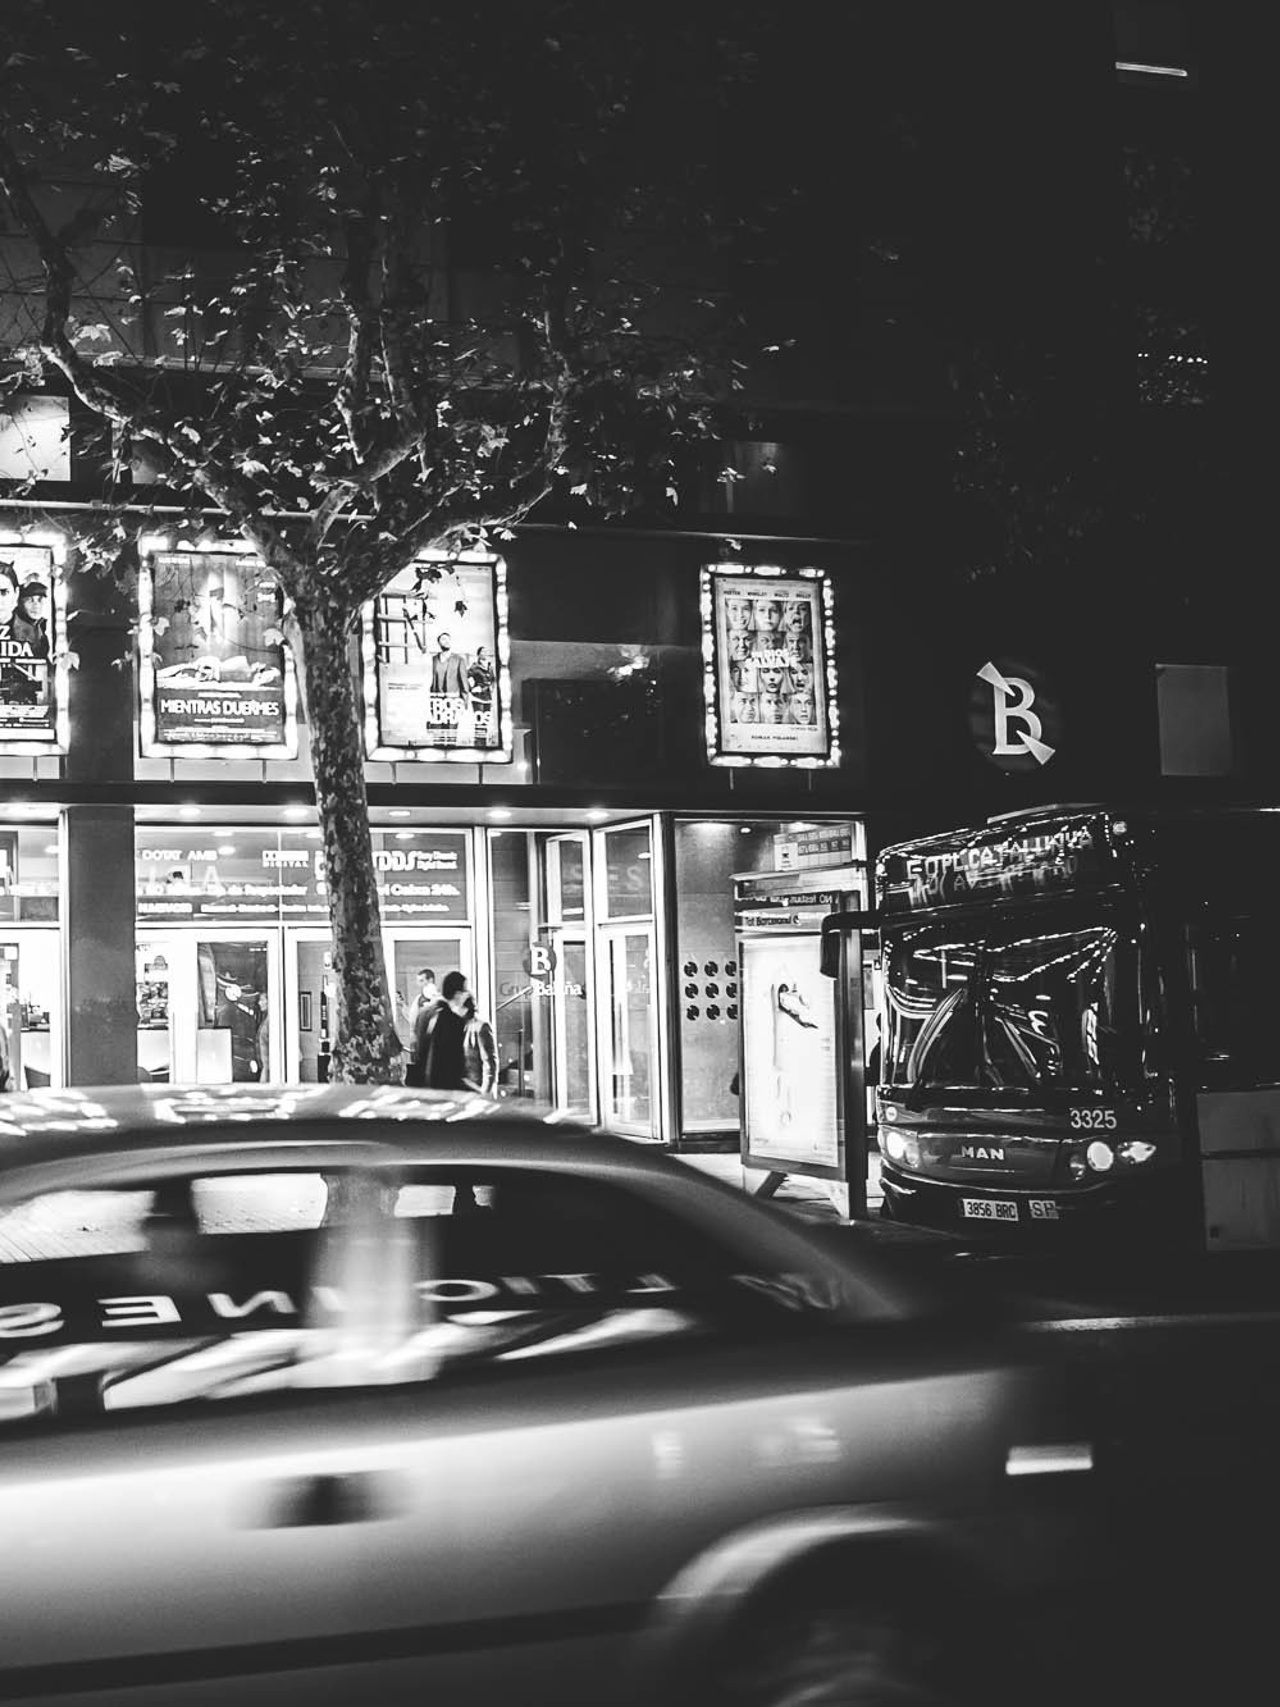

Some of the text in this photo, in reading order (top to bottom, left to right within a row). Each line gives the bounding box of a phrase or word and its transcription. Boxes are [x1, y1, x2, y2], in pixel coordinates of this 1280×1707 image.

[160, 699, 220, 715] MIENTRAS
[1070, 1110, 1117, 1129] 3325
[961, 1146, 1005, 1161] MAN
[966, 1201, 1016, 1219] 3856 BRC
